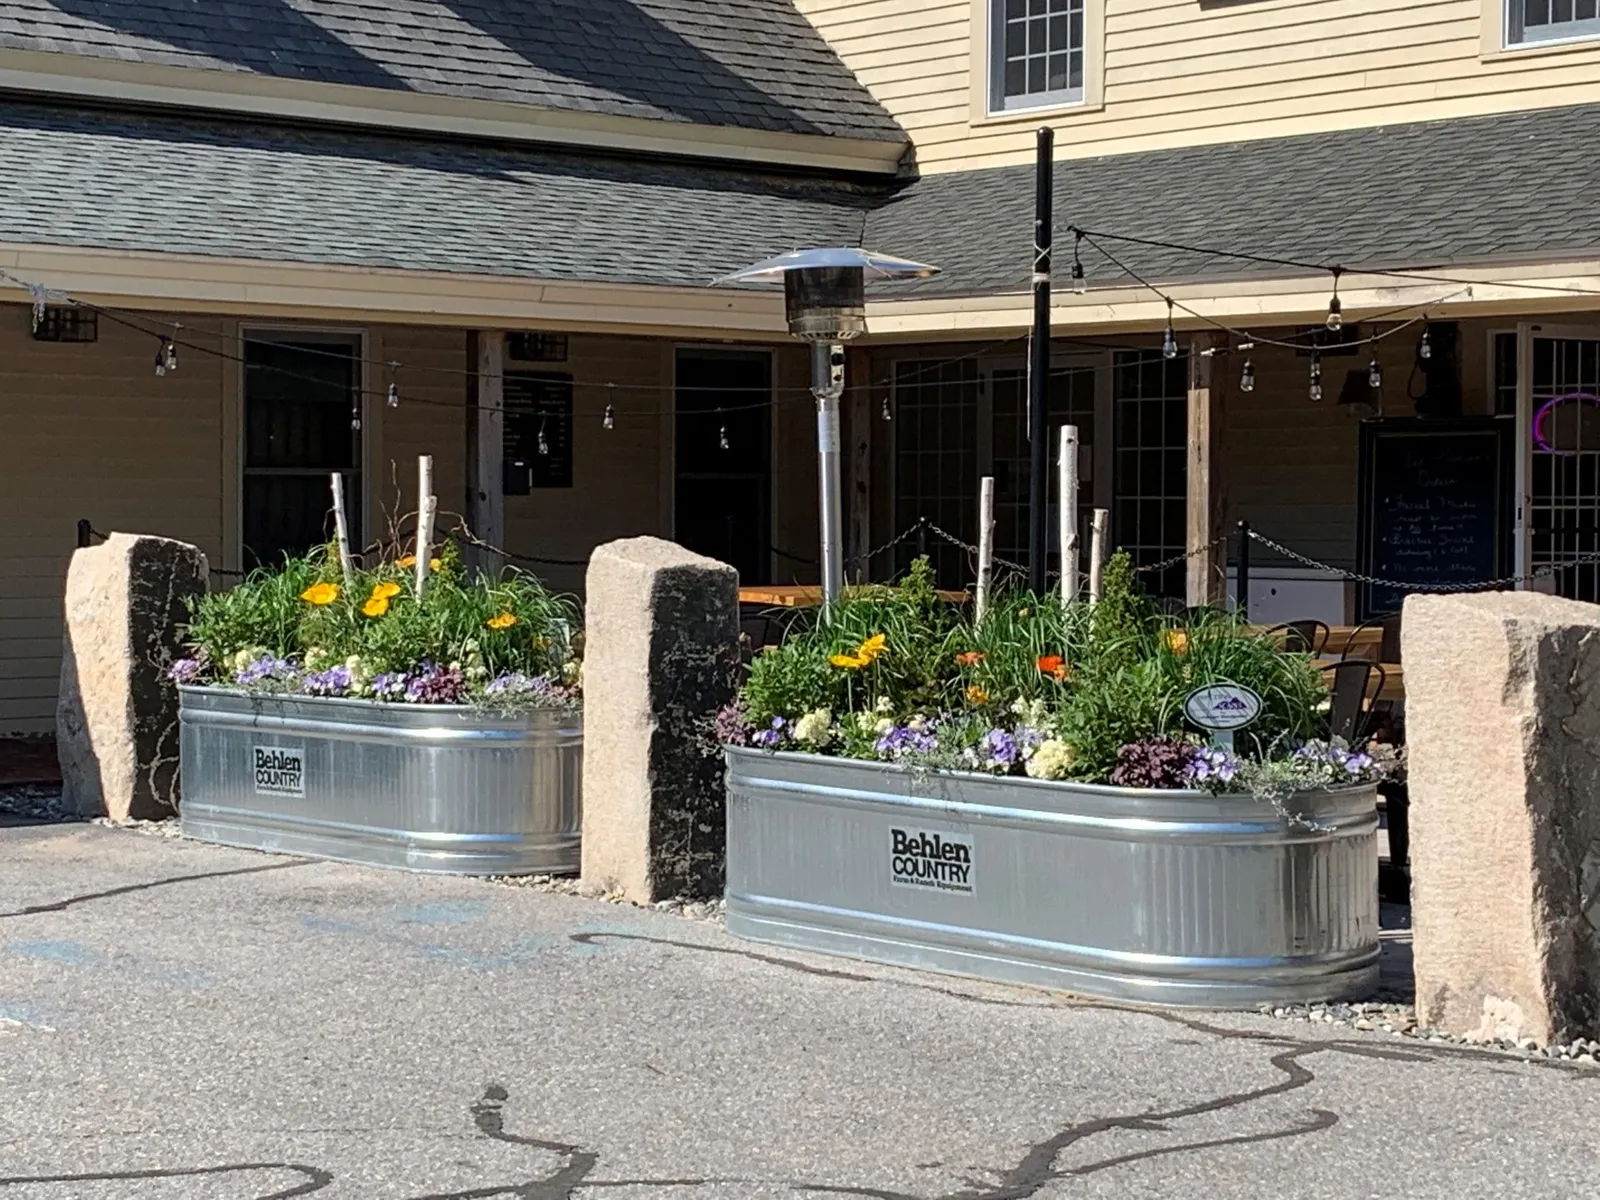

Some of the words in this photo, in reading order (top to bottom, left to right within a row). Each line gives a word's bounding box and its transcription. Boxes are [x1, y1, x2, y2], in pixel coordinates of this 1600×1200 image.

[255, 749, 302, 772] Behlen
[256, 769, 301, 788] COUNTRY
[891, 828, 971, 864] Behlen
[892, 855, 971, 883] COUNTRY
